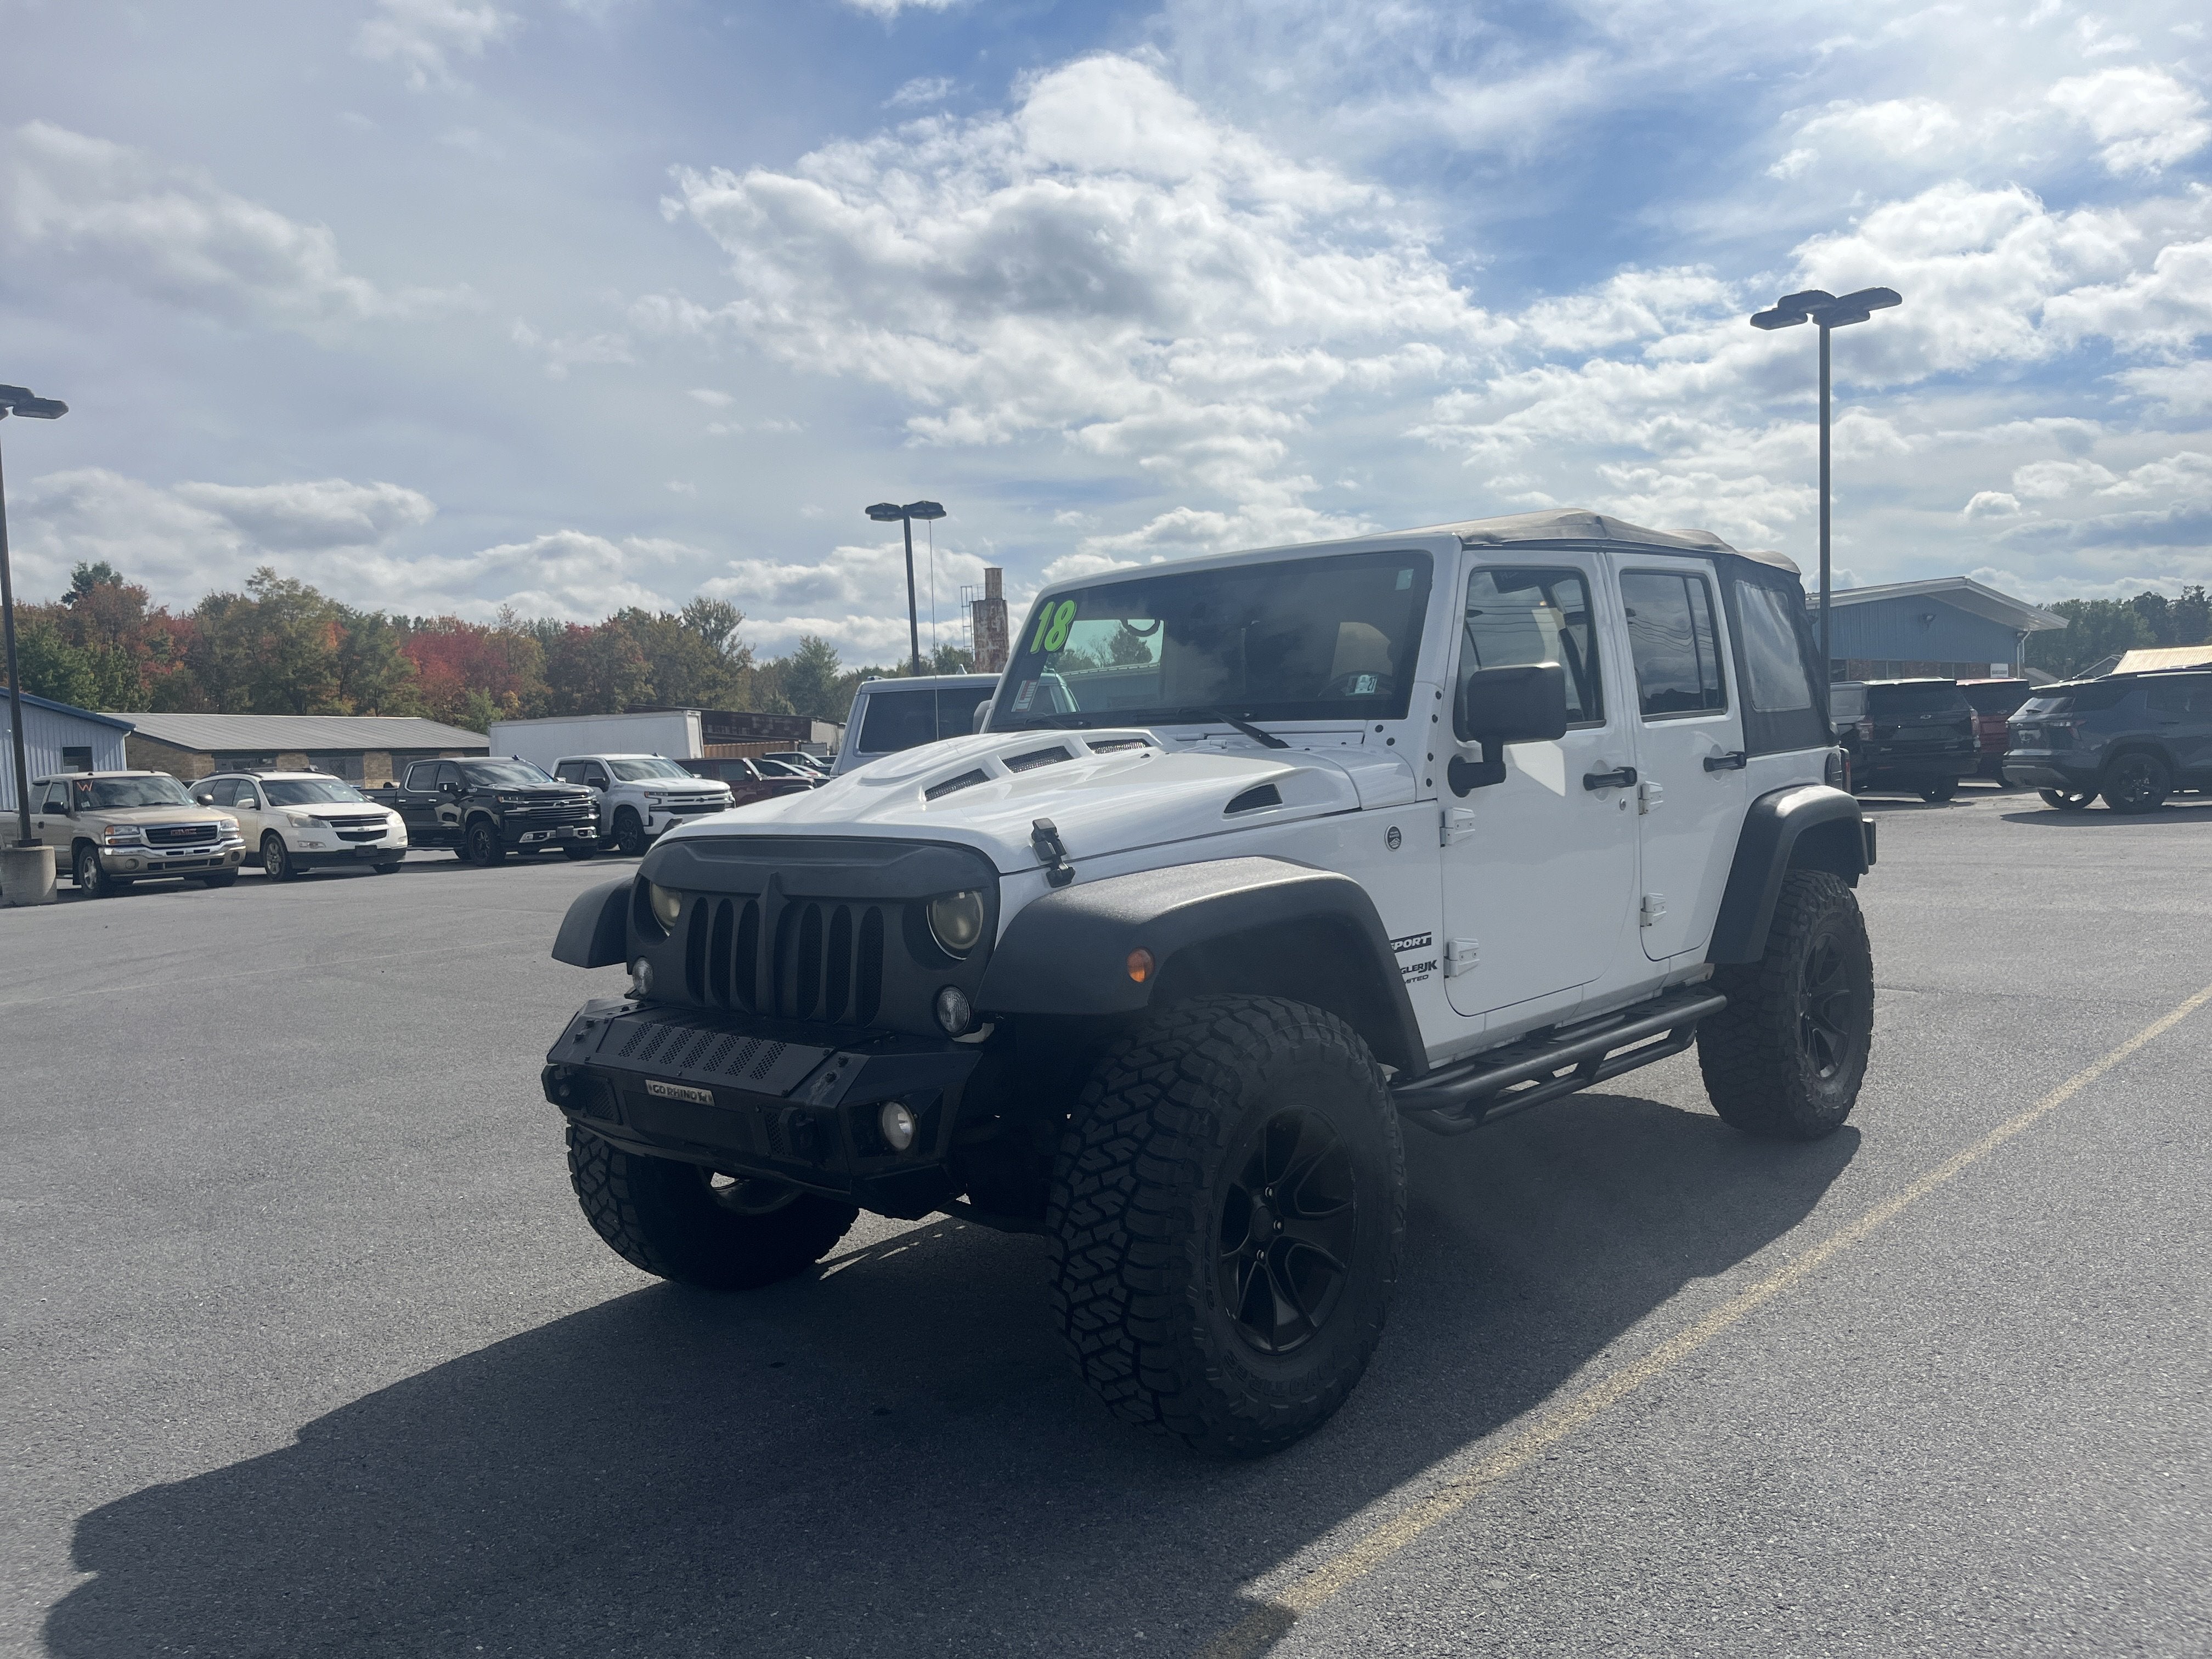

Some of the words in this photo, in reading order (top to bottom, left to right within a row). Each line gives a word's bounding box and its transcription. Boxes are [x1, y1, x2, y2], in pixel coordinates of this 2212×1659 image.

[1030, 600, 1077, 654] 18
[653, 1085, 665, 1094] GO
[667, 1087, 697, 1100] RHINO
